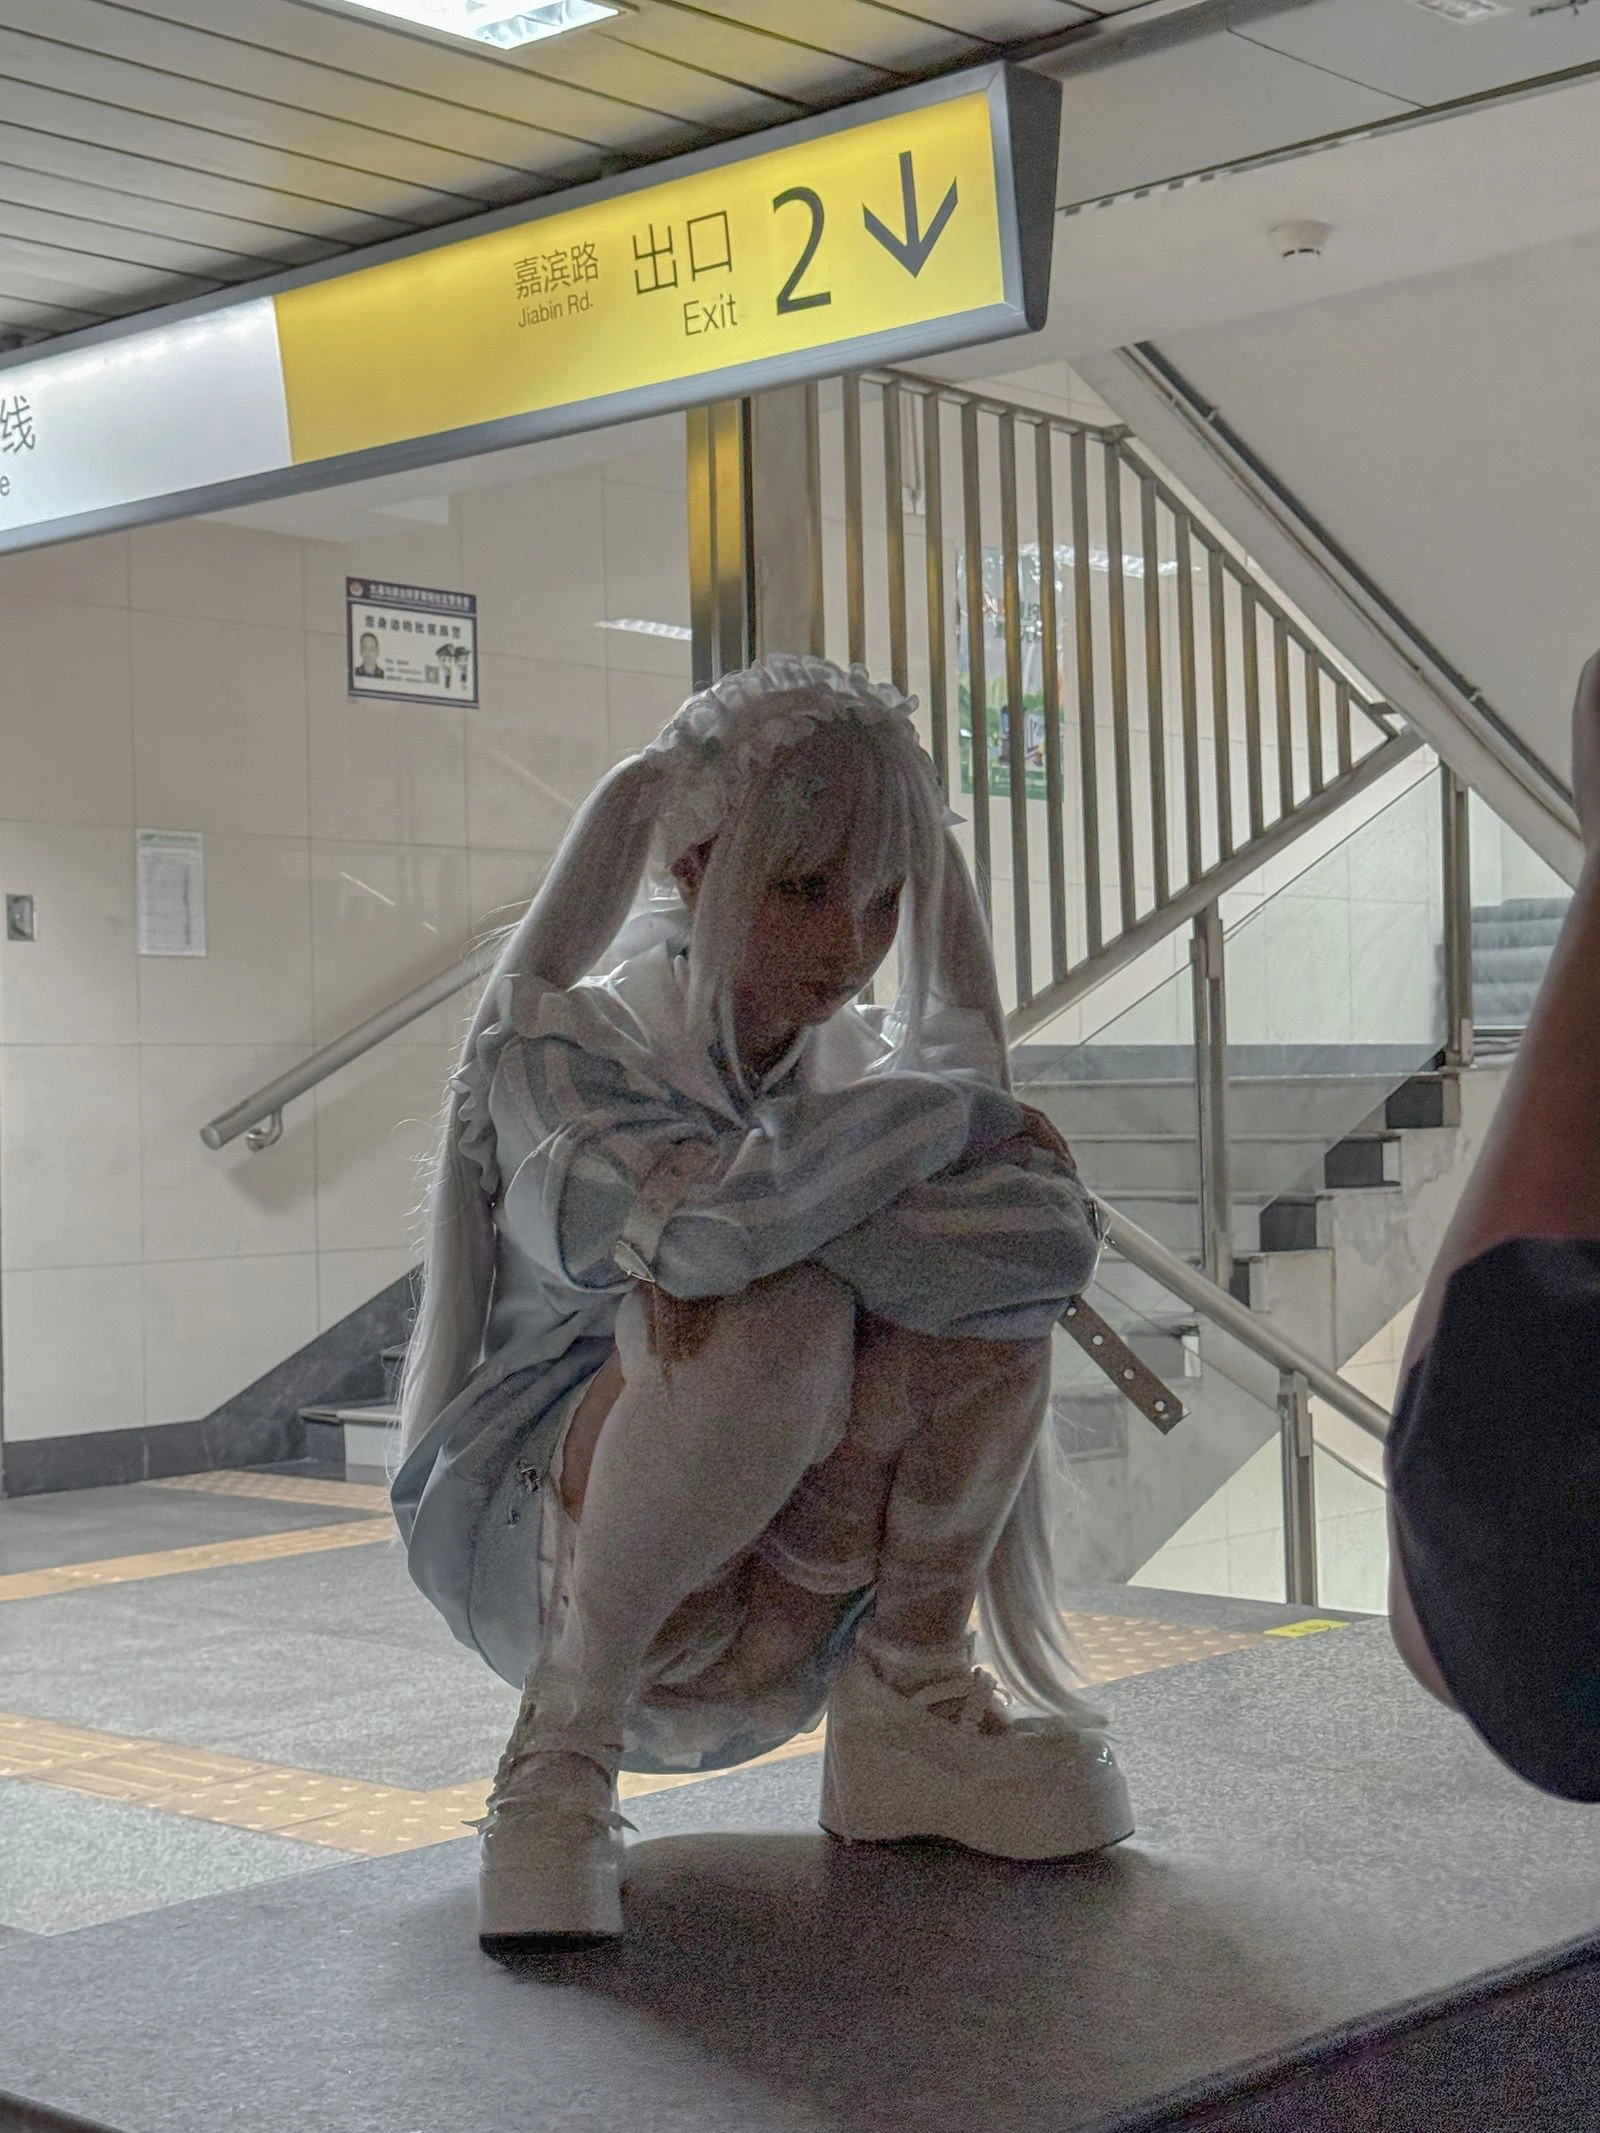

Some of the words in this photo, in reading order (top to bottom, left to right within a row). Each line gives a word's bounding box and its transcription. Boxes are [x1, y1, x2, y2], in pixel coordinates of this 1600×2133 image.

[513, 240, 599, 299] 嘉滨路
[631, 210, 733, 295] 出口
[772, 186, 832, 316] 2
[518, 300, 563, 328] Jiabin
[567, 290, 593, 315] Rd.
[683, 294, 738, 336] Exit
[0, 395, 36, 453] 线
